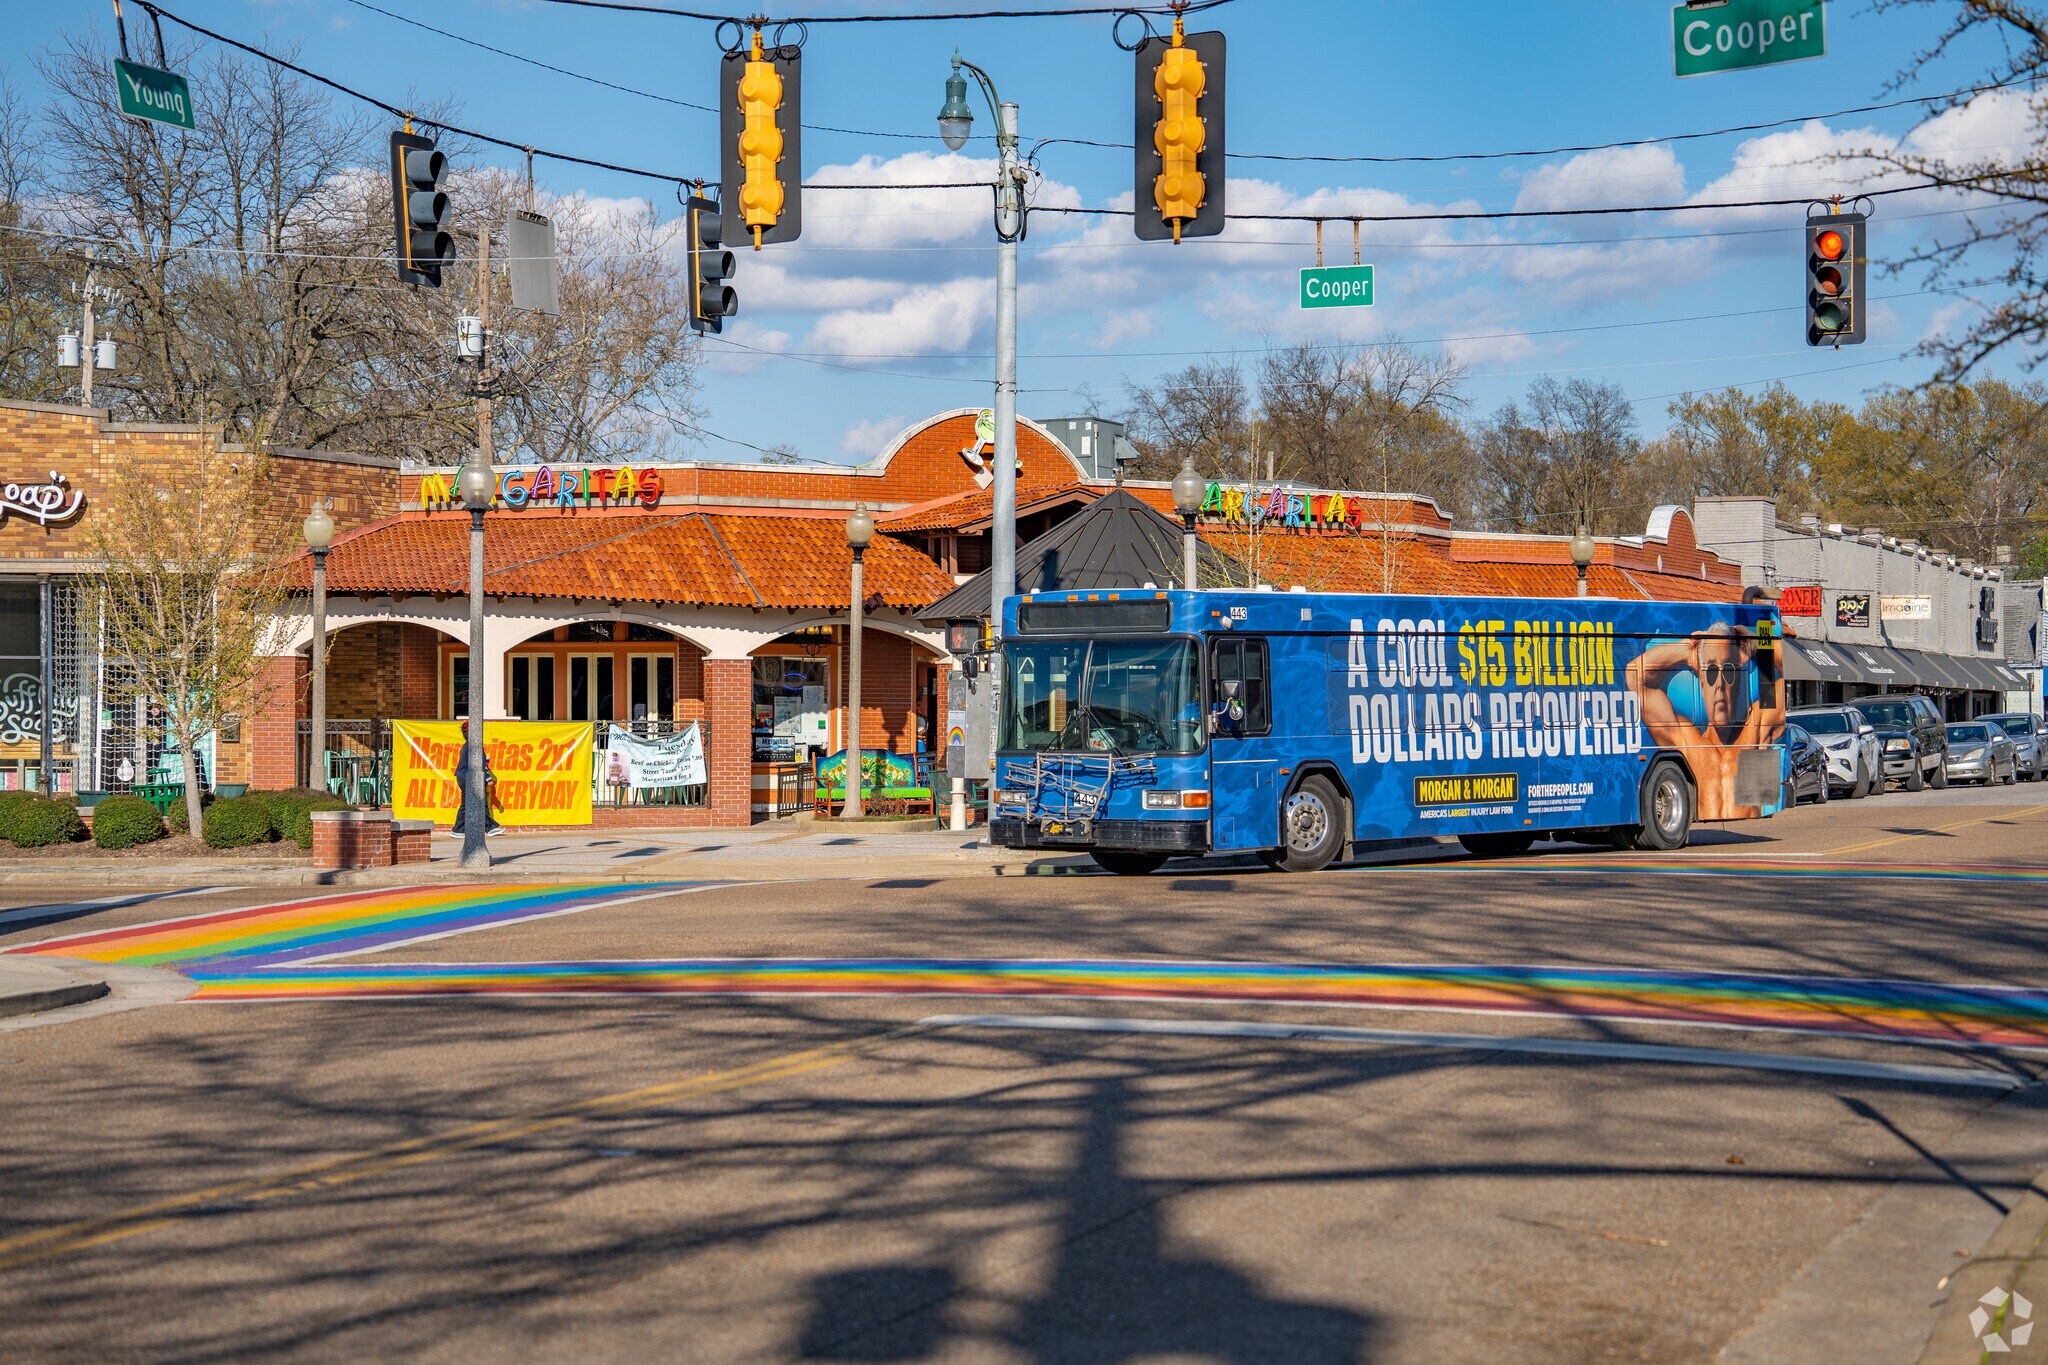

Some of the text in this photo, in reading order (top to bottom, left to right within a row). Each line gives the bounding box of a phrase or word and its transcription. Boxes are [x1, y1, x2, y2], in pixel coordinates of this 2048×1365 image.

[1683, 12, 1814, 56] Cooper
[124, 73, 186, 123] Young
[1306, 277, 1369, 301] Cooper
[421, 465, 660, 510] MGARITAS
[0, 483, 83, 525] oap
[1180, 481, 1362, 528] ARGARITAS
[1231, 607, 1247, 619] 443
[1882, 603, 1929, 615] Imagine
[1347, 618, 1615, 688] A COOL $15 BILLION
[1348, 690, 1642, 764] DOLLARS RECOVERED
[409, 737, 577, 775] Margitas 2x1
[631, 758, 644, 766] Beef
[641, 775, 673, 784] Margaritas
[1419, 777, 1514, 802] MORGAN & MORGAN
[1527, 782, 1594, 798] FORTHEPEOPLE.COM
[404, 778, 579, 810] ALL DA VERYDAY
[1074, 792, 1097, 805] 443
[1419, 806, 1514, 819] AMERICA'S LARGEST INJURY LAW FIRM
